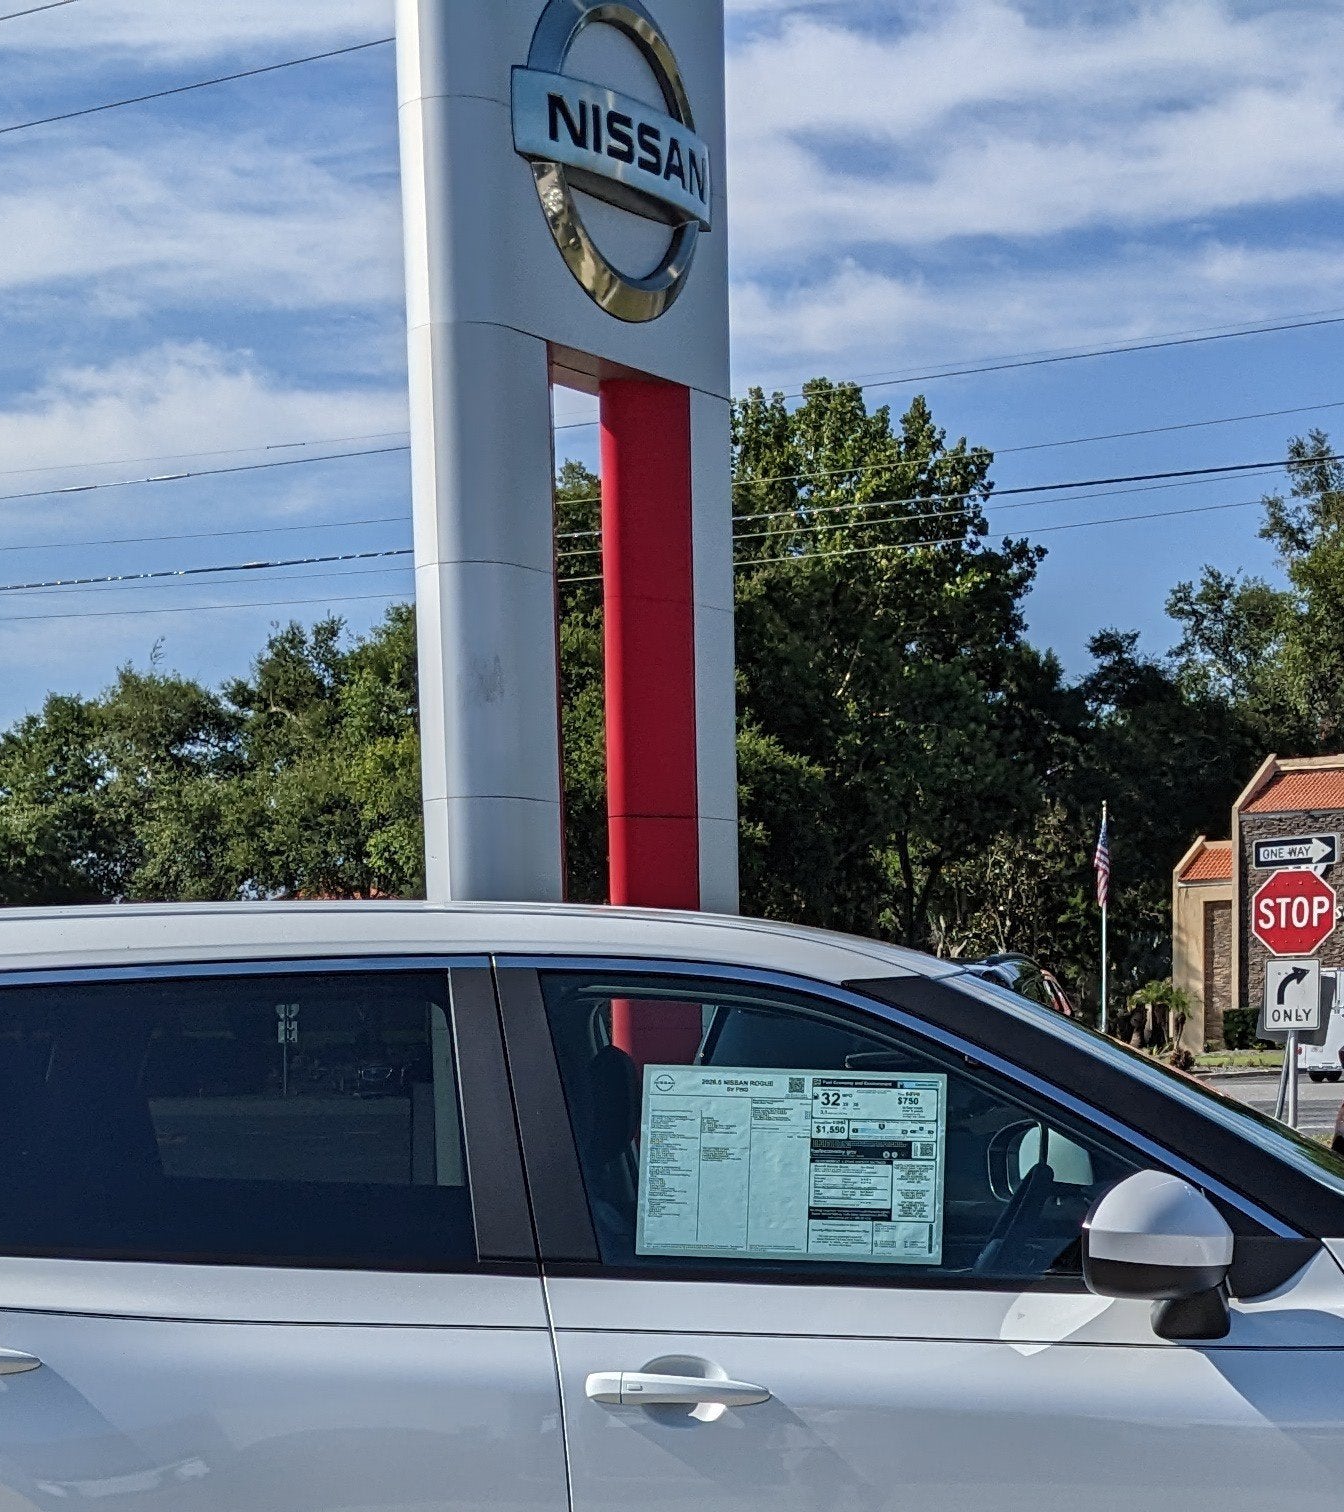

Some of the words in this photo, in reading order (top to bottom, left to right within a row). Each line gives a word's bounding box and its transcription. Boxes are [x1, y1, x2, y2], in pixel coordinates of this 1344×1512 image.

[546, 91, 707, 206] NISSAN
[1262, 848, 1284, 860] ONE
[1287, 845, 1311, 858] WAY
[1258, 896, 1330, 930] STOP
[1271, 1008, 1313, 1023] ONLY
[821, 1092, 841, 1107] 32
